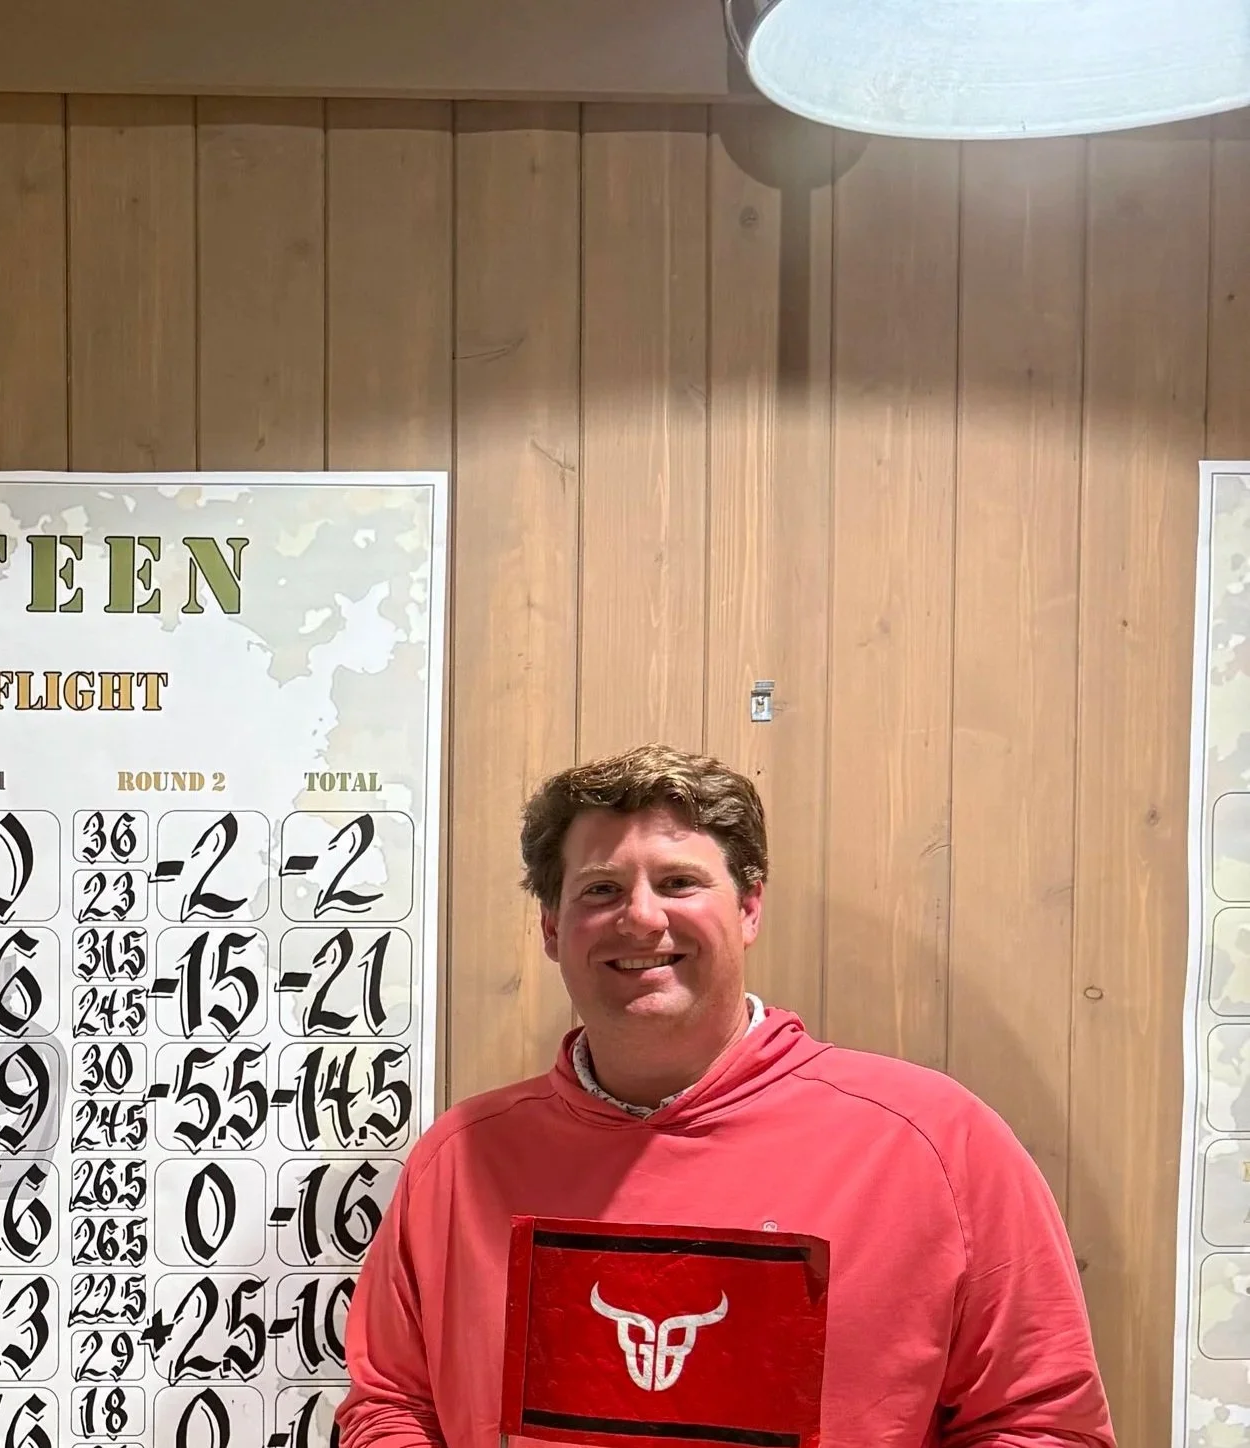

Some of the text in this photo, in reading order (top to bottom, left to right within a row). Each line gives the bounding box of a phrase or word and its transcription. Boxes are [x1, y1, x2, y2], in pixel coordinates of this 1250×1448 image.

[117, 771, 226, 792] ROUND 2
[304, 772, 382, 792] TOTAL
[82, 811, 136, 863] 36
[148, 811, 248, 923] -2
[279, 813, 384, 918] -2
[78, 871, 135, 924] 23
[73, 987, 147, 1038] 24.5
[146, 930, 259, 1042] -15
[274, 928, 392, 1037] -21
[80, 1042, 133, 1095] 30
[142, 1042, 271, 1154] -5.5
[270, 1043, 412, 1150] -14.5
[181, 1162, 236, 1267] 0
[267, 1160, 383, 1266] -16
[75, 1330, 134, 1382] 29
[79, 1386, 128, 1441] 18
